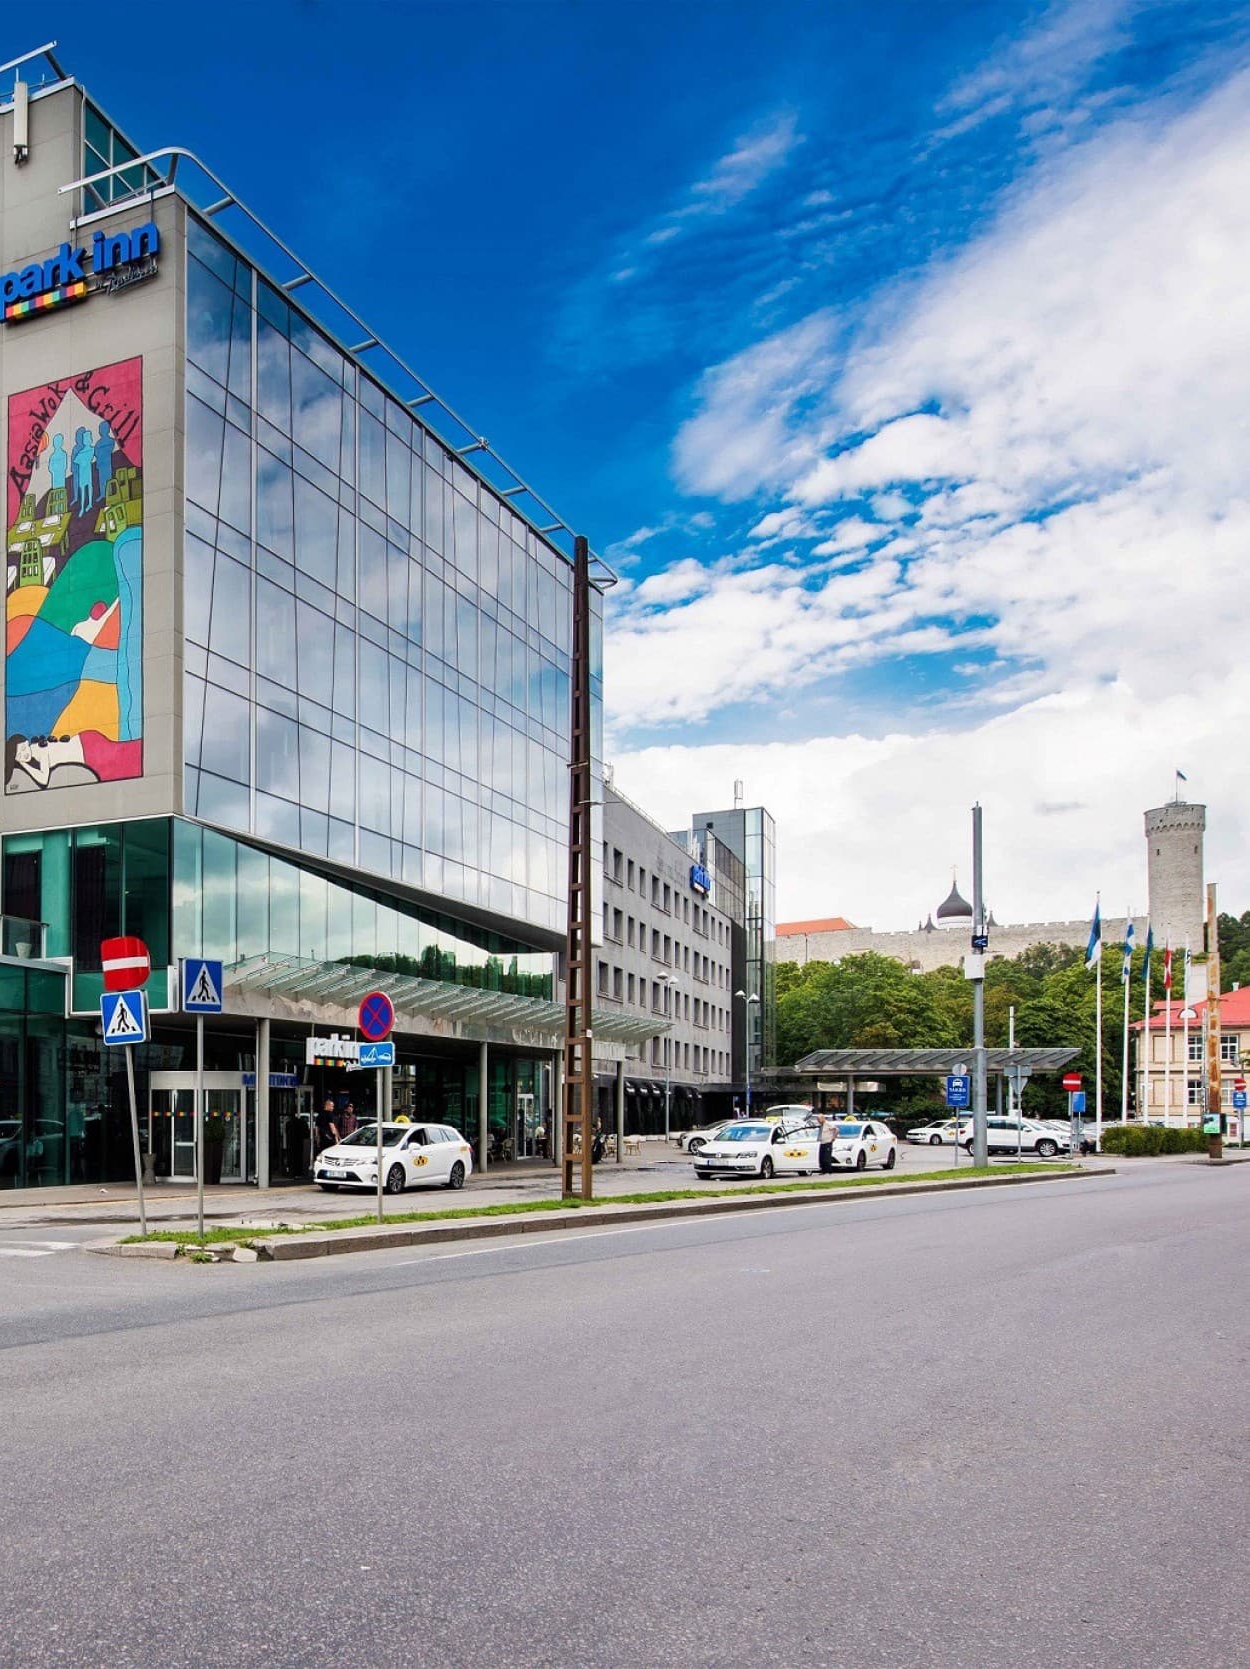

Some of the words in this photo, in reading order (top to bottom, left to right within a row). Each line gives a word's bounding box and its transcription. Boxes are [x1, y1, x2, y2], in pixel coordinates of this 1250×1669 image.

[92, 221, 160, 275] inn
[29, 383, 68, 425] Wok
[75, 370, 94, 393] &
[88, 386, 140, 448] Grill
